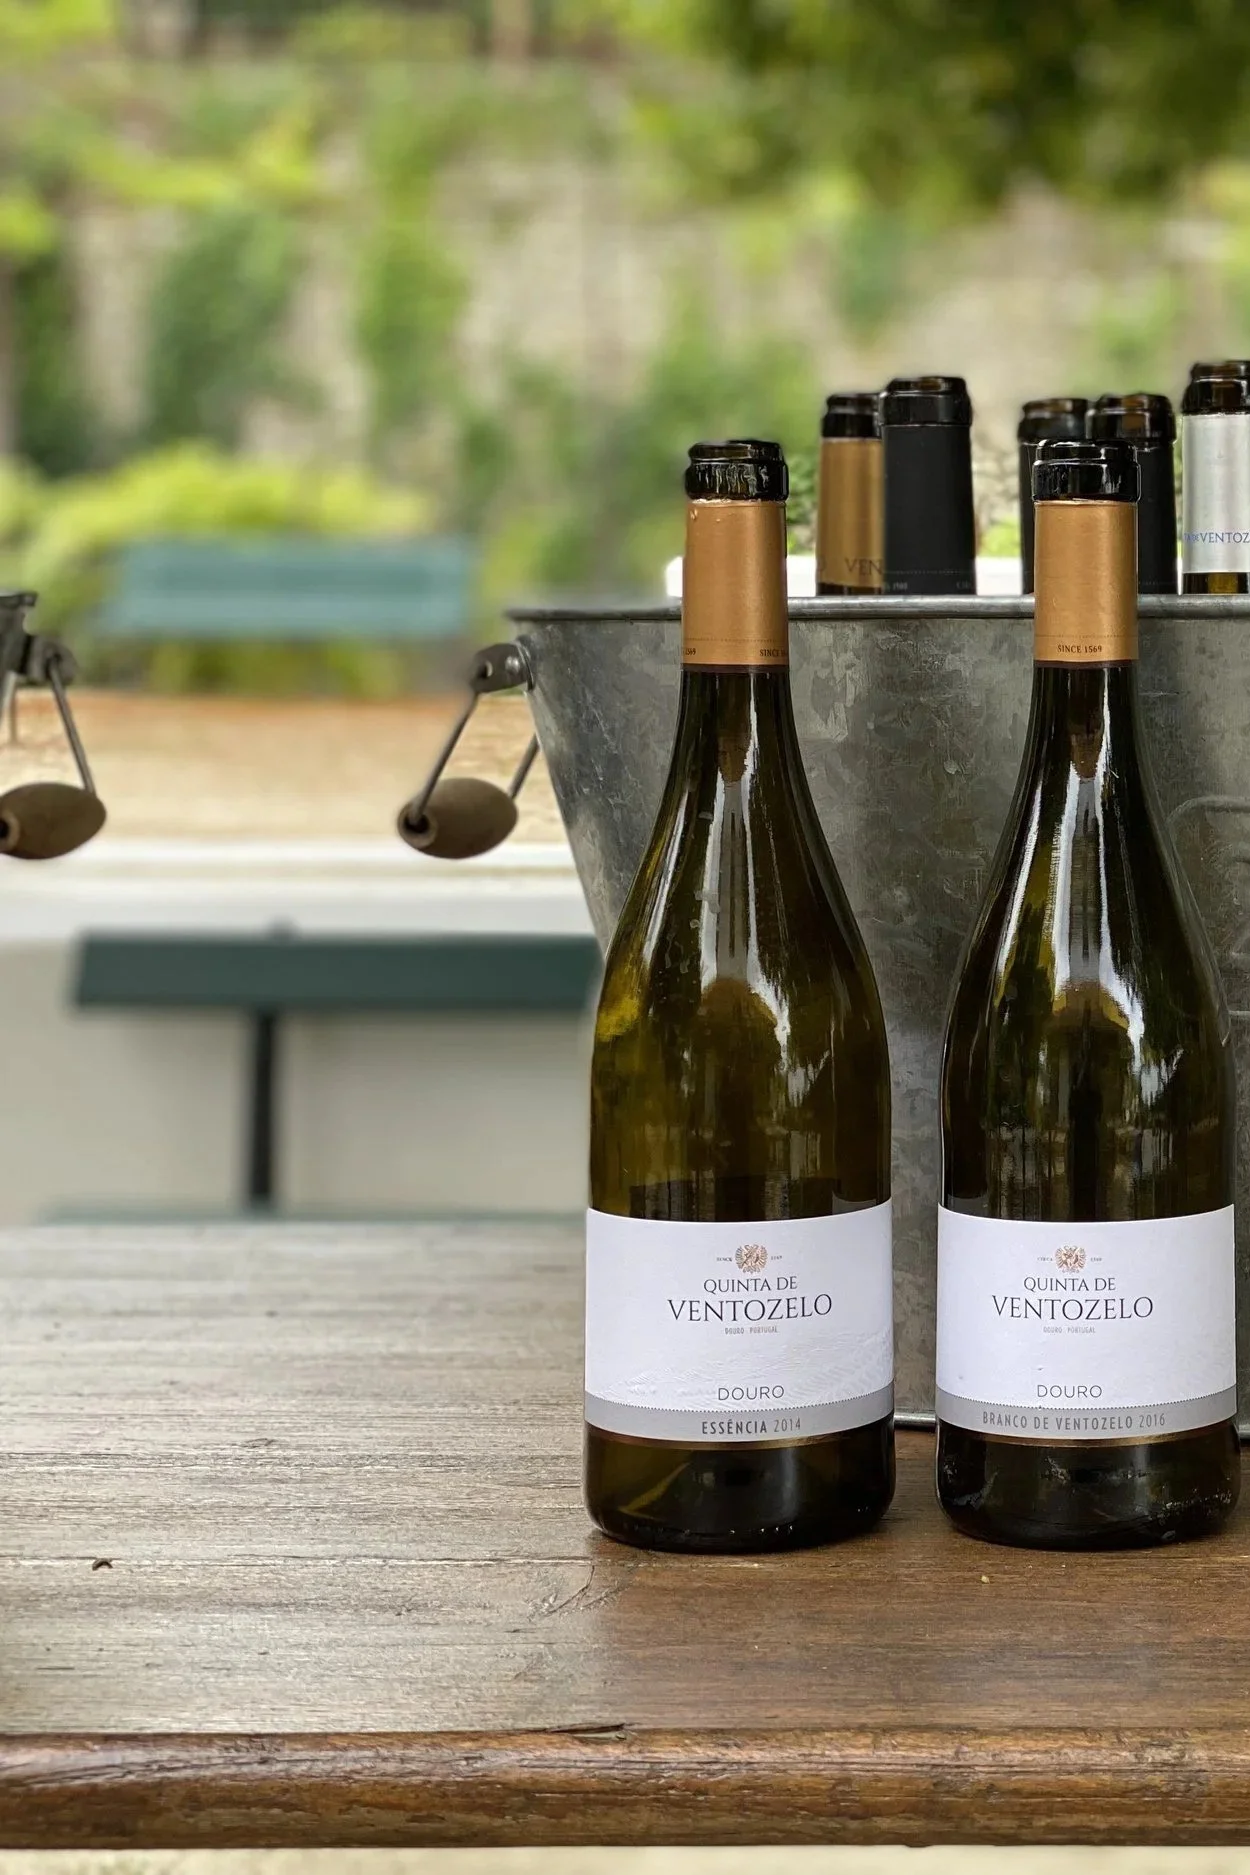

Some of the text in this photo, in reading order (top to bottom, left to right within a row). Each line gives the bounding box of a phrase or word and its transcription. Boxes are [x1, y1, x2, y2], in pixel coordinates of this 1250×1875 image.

[1057, 644, 1102, 653] SINCE 1569
[703, 1275, 798, 1295] QUINTA DE
[1023, 1276, 1116, 1292] QUINTA DE
[667, 1293, 832, 1322] VENTOZELO
[991, 1295, 1153, 1321] VENTOZELO
[1067, 1326, 1096, 1334] PORTUGAL
[718, 1385, 785, 1401] DOURO
[1037, 1384, 1103, 1398] DOURO
[773, 1417, 801, 1433] 2014
[982, 1411, 1166, 1430] BRANCO DE VENTOZELO 2016
